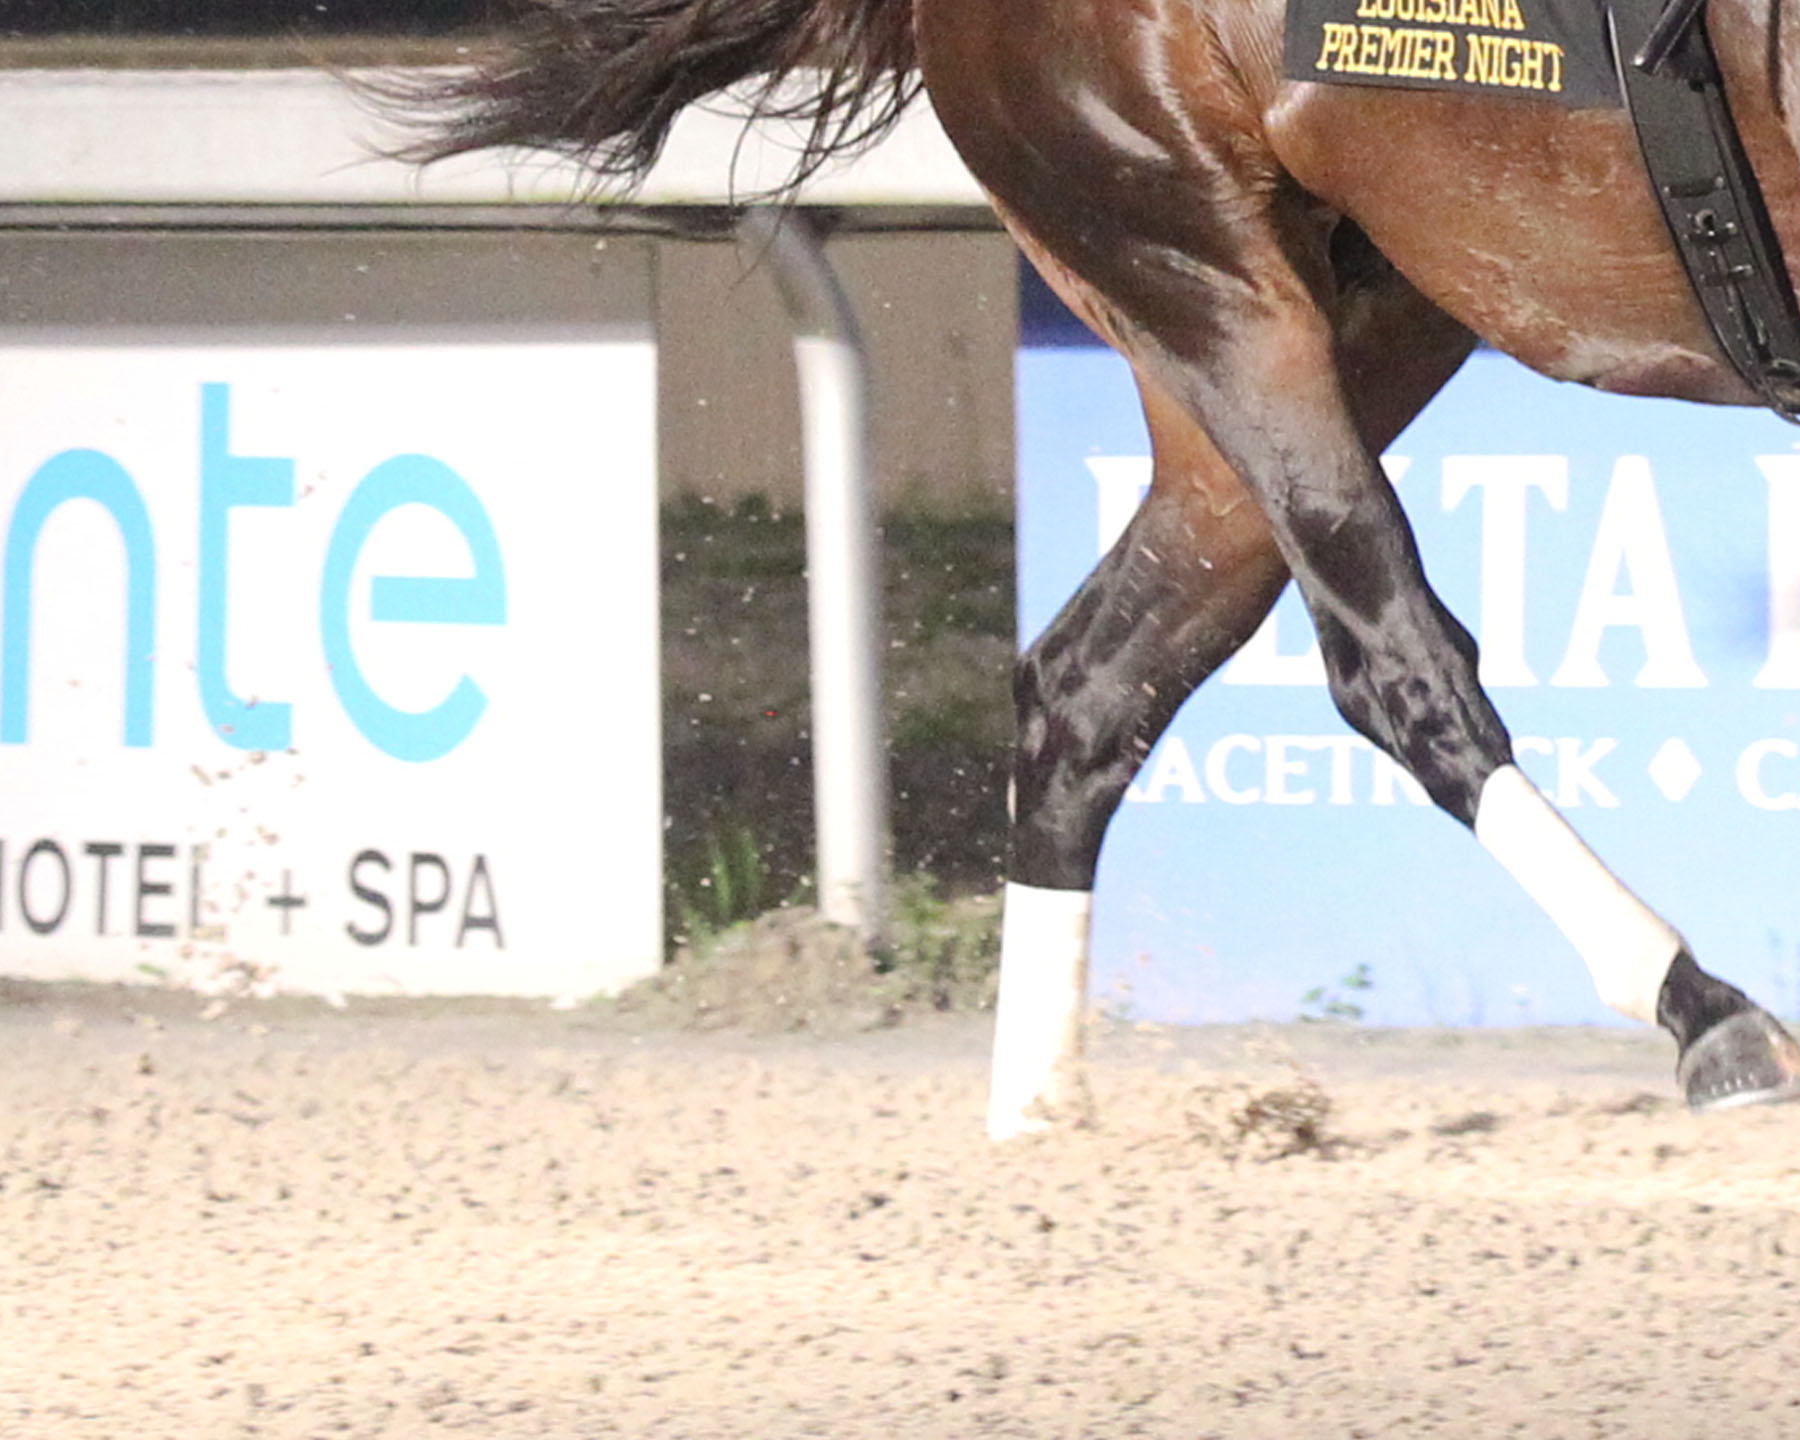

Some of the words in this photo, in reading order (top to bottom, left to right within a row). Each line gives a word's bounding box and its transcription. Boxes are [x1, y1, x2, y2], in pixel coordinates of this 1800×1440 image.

[1315, 22, 1458, 81] PREMIER
[1463, 33, 1565, 93] NIGHT
[0, 381, 508, 763] nte
[0, 838, 227, 942] OTEL
[345, 849, 506, 950] SPA
